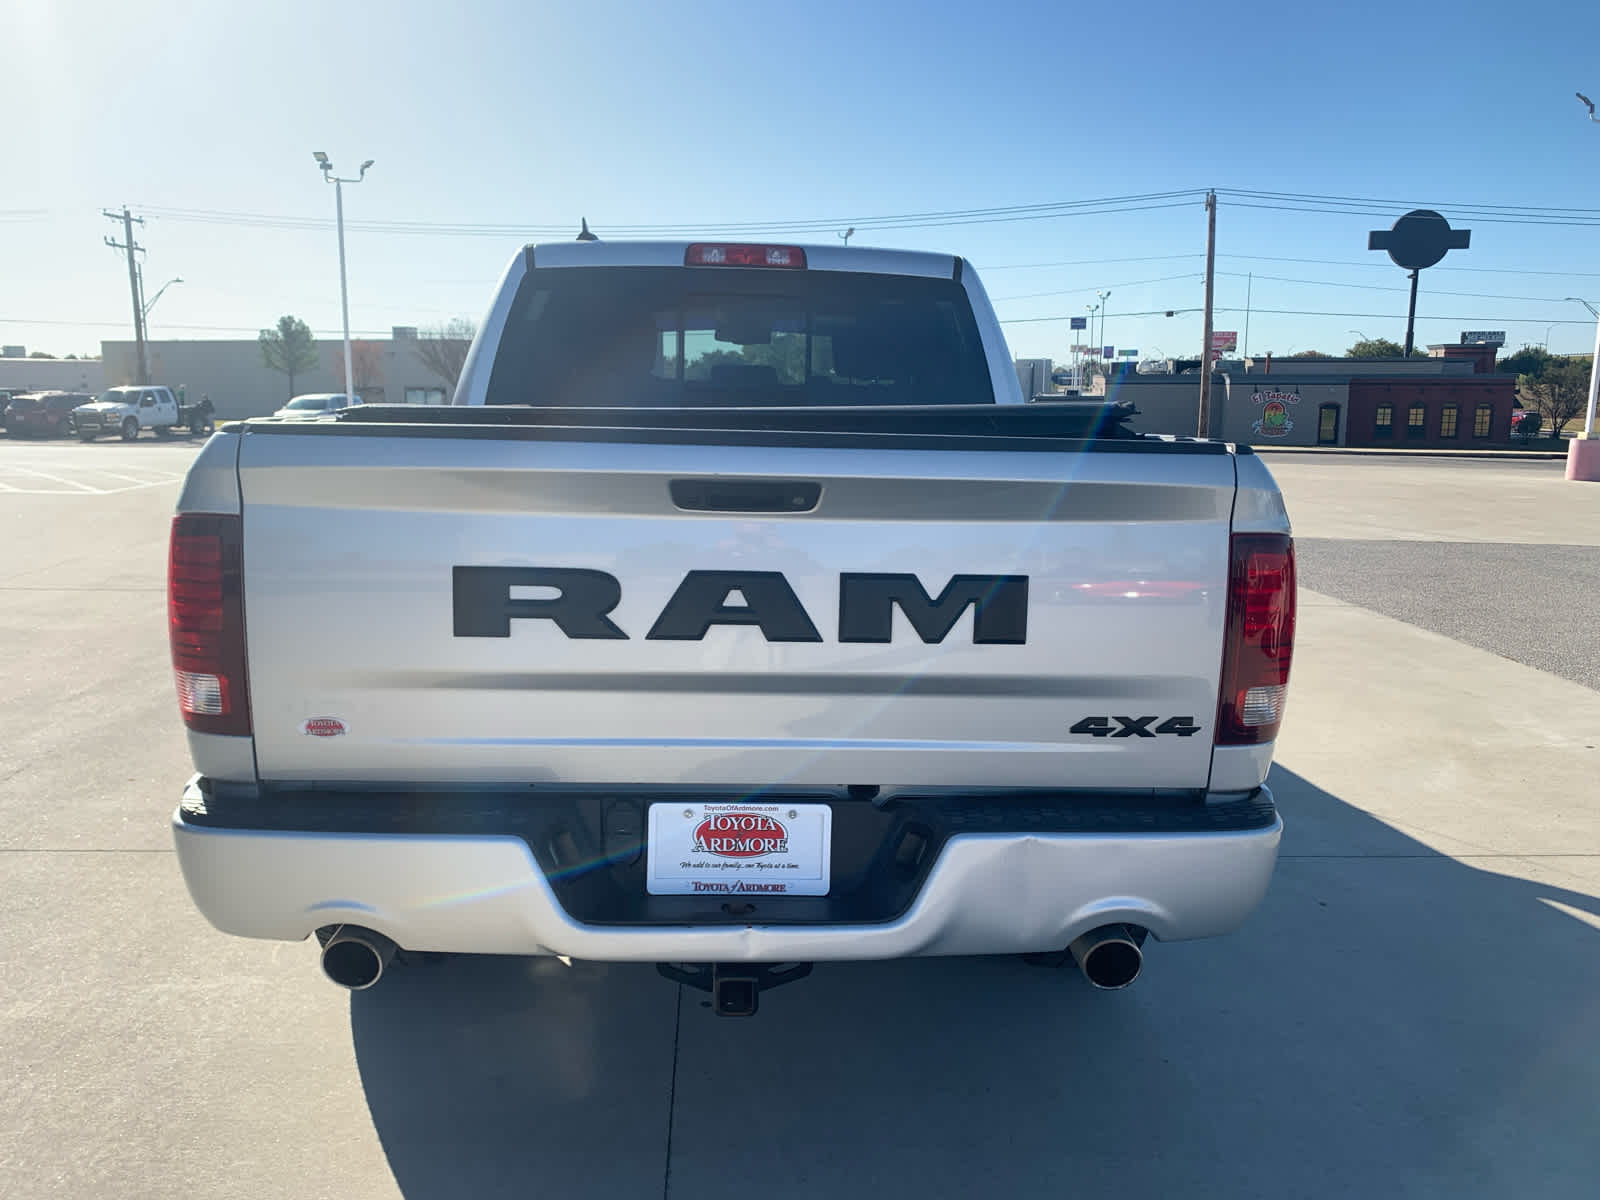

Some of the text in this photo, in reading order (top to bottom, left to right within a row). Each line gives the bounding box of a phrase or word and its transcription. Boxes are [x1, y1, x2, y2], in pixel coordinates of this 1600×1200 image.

[453, 566, 1029, 644] RAM
[704, 813, 777, 831] TOYOTA
[692, 835, 788, 853] ARDMORE
[691, 881, 729, 892] TOYOTA
[736, 881, 787, 893] ARDMORE
